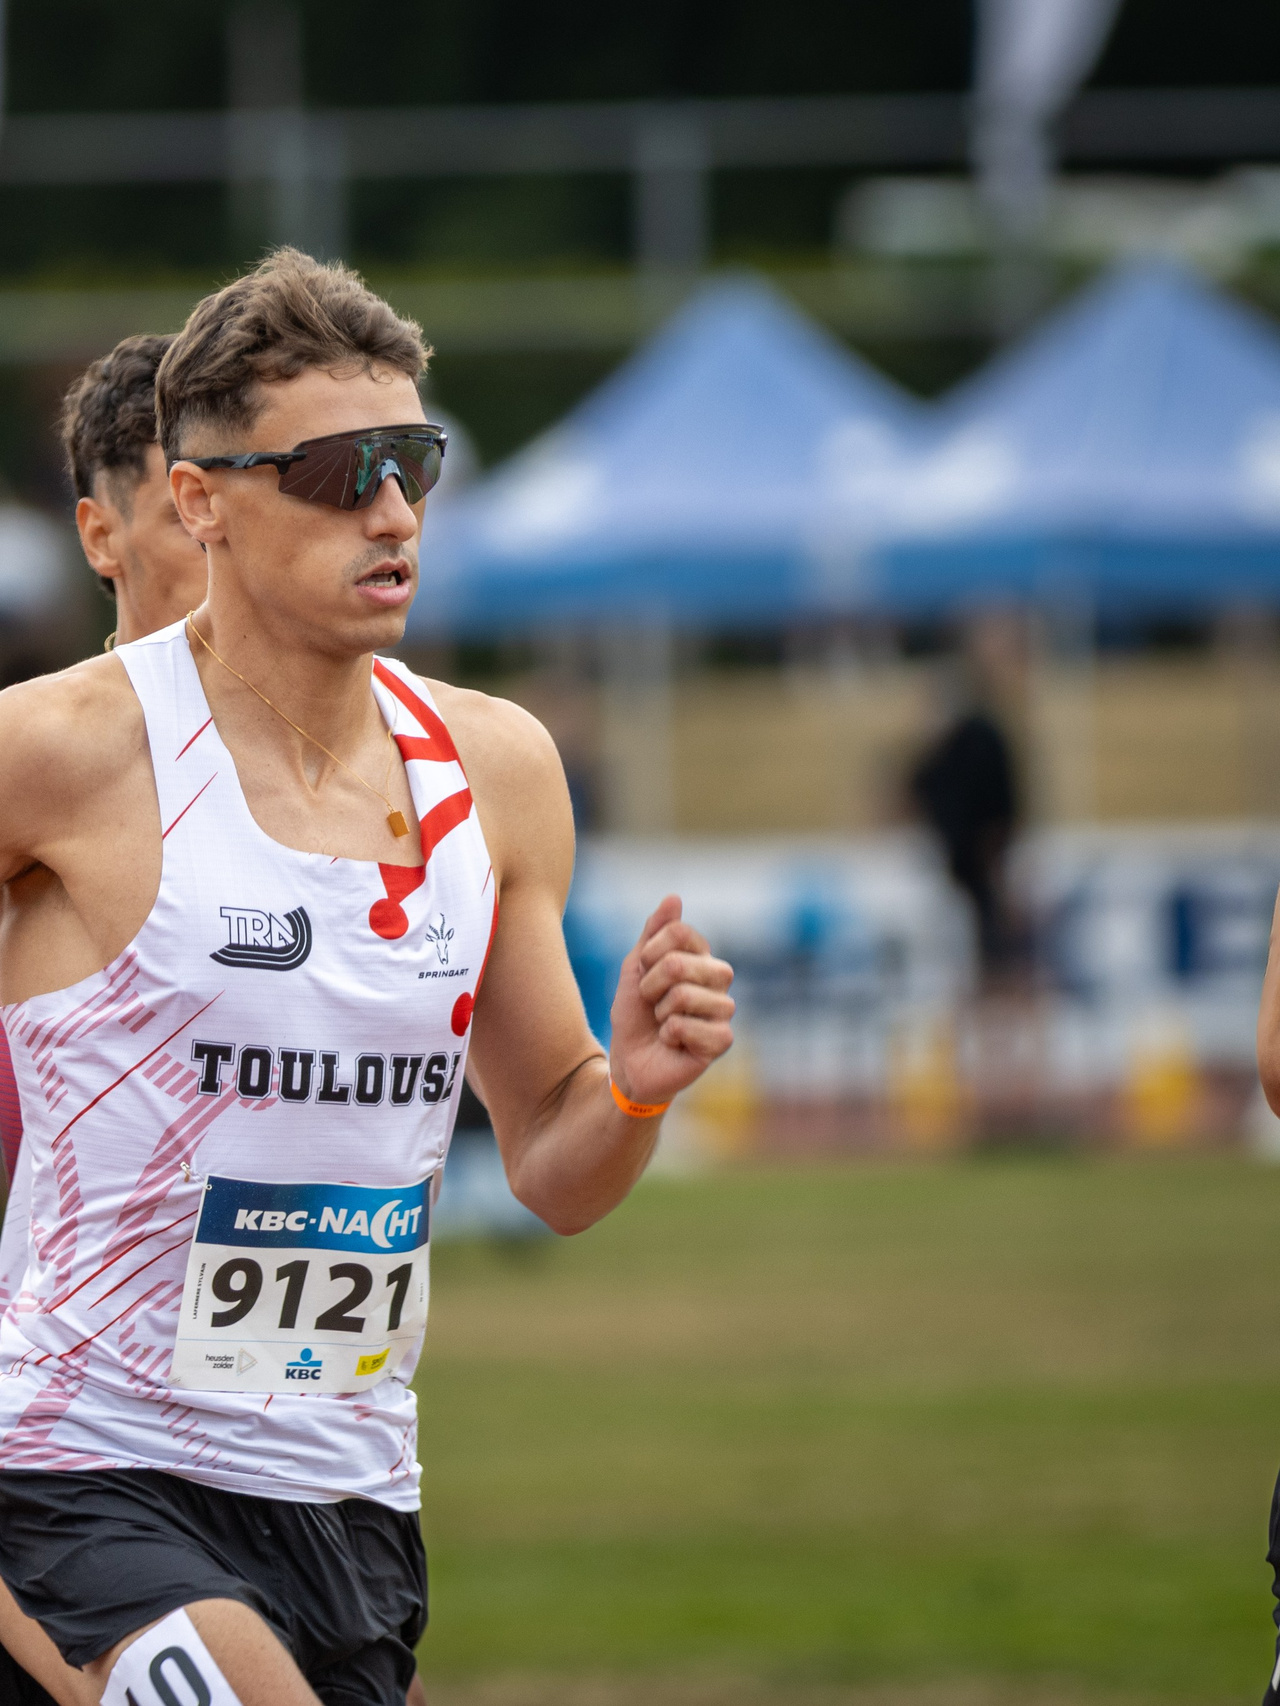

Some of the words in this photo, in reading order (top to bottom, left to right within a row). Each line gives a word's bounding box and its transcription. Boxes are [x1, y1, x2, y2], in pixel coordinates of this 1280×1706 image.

[418, 967, 470, 979] SPRINGART
[210, 1258, 413, 1334] 9121
[205, 1354, 235, 1362] heusden
[285, 1368, 322, 1381] KBC
